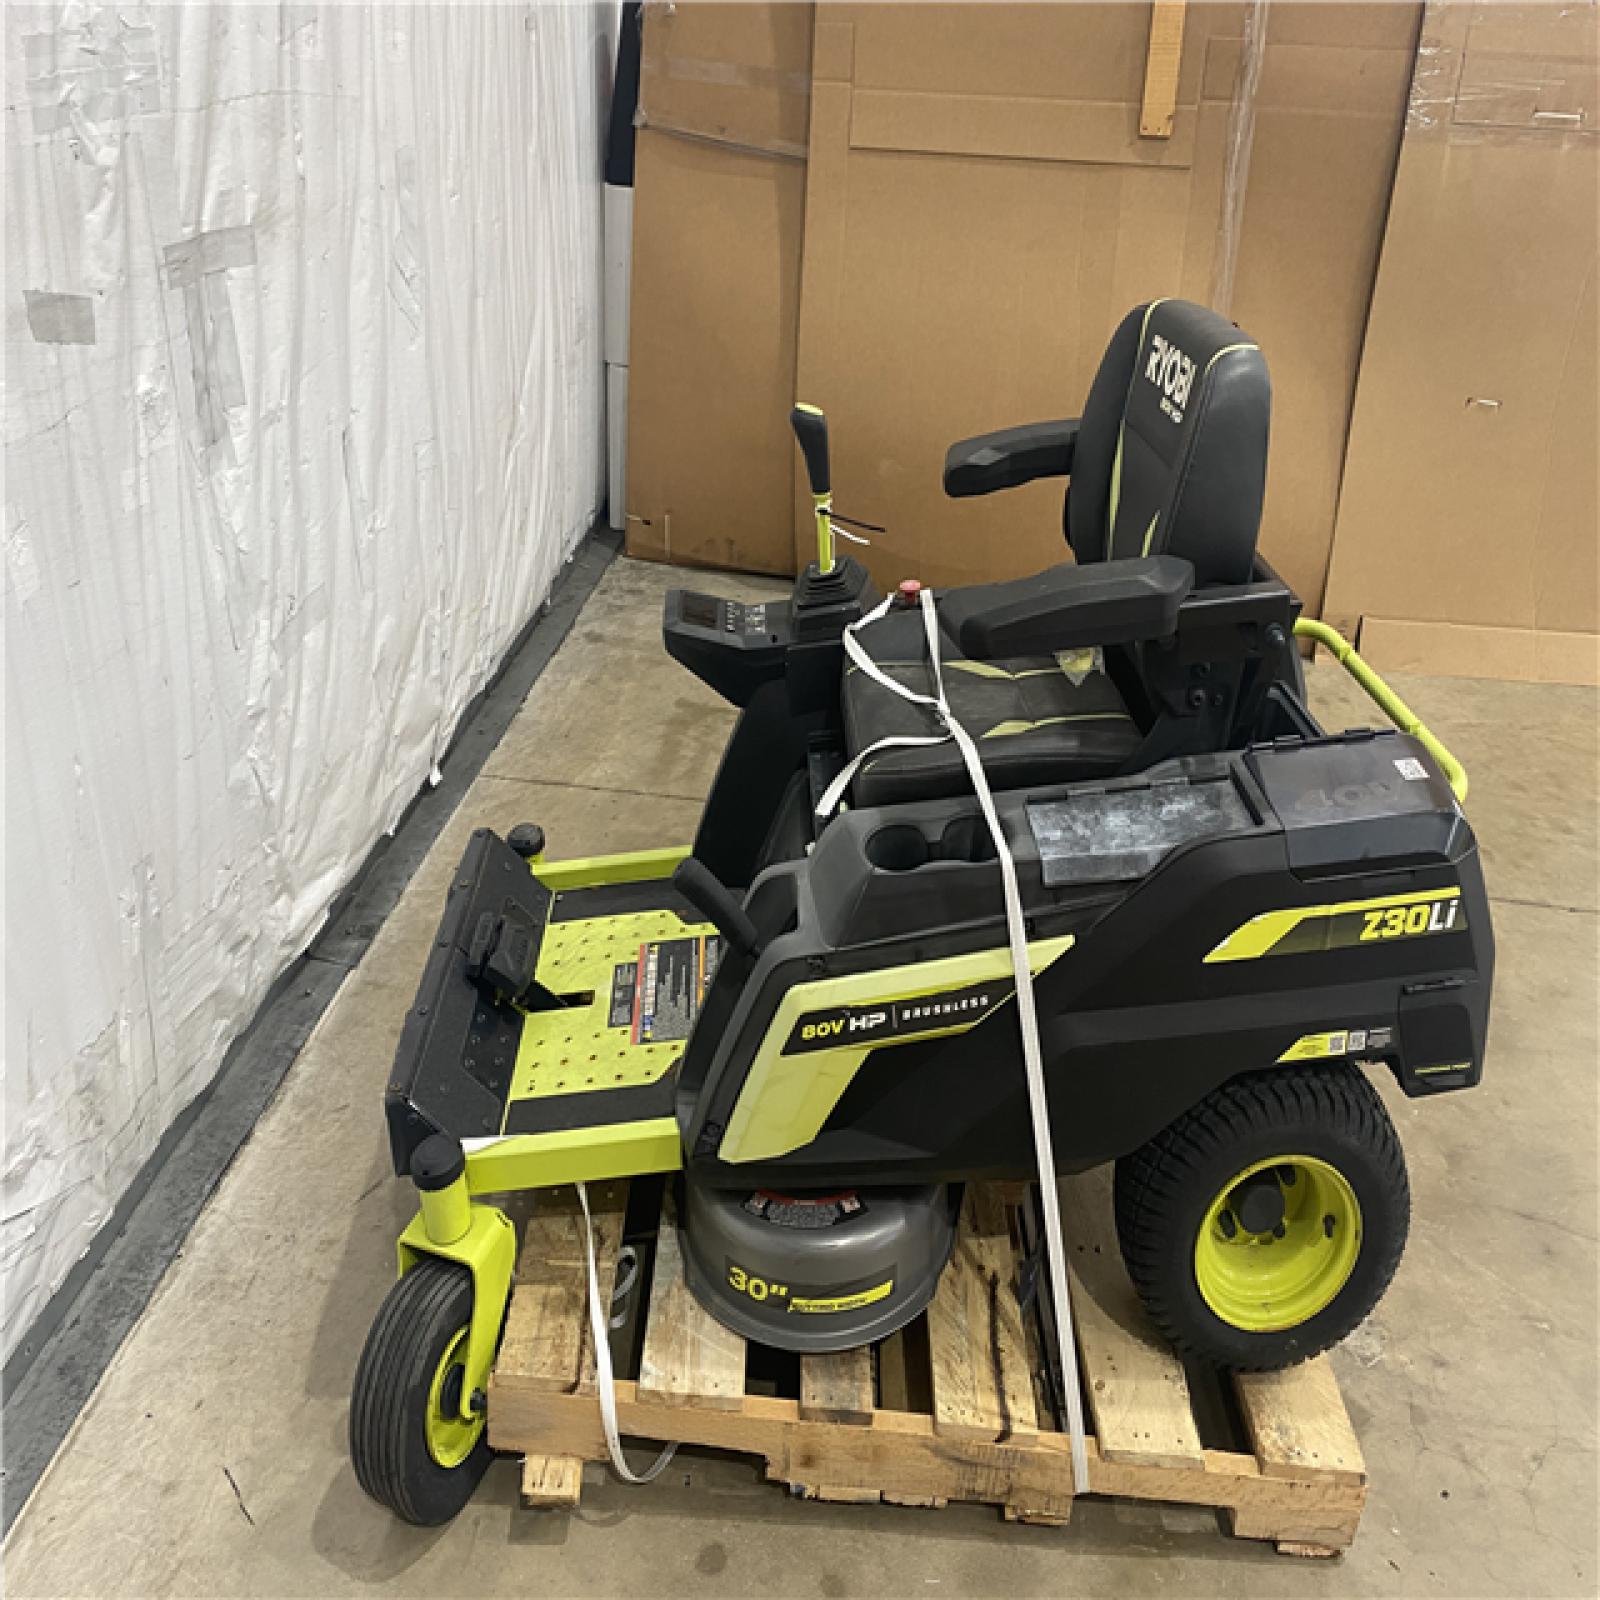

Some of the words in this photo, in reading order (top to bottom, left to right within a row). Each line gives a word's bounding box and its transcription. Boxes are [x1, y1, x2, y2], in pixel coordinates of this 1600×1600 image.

[1145, 335, 1197, 410] RYOBI
[1360, 899, 1459, 940] Z30Li
[849, 1012, 886, 1032] HP
